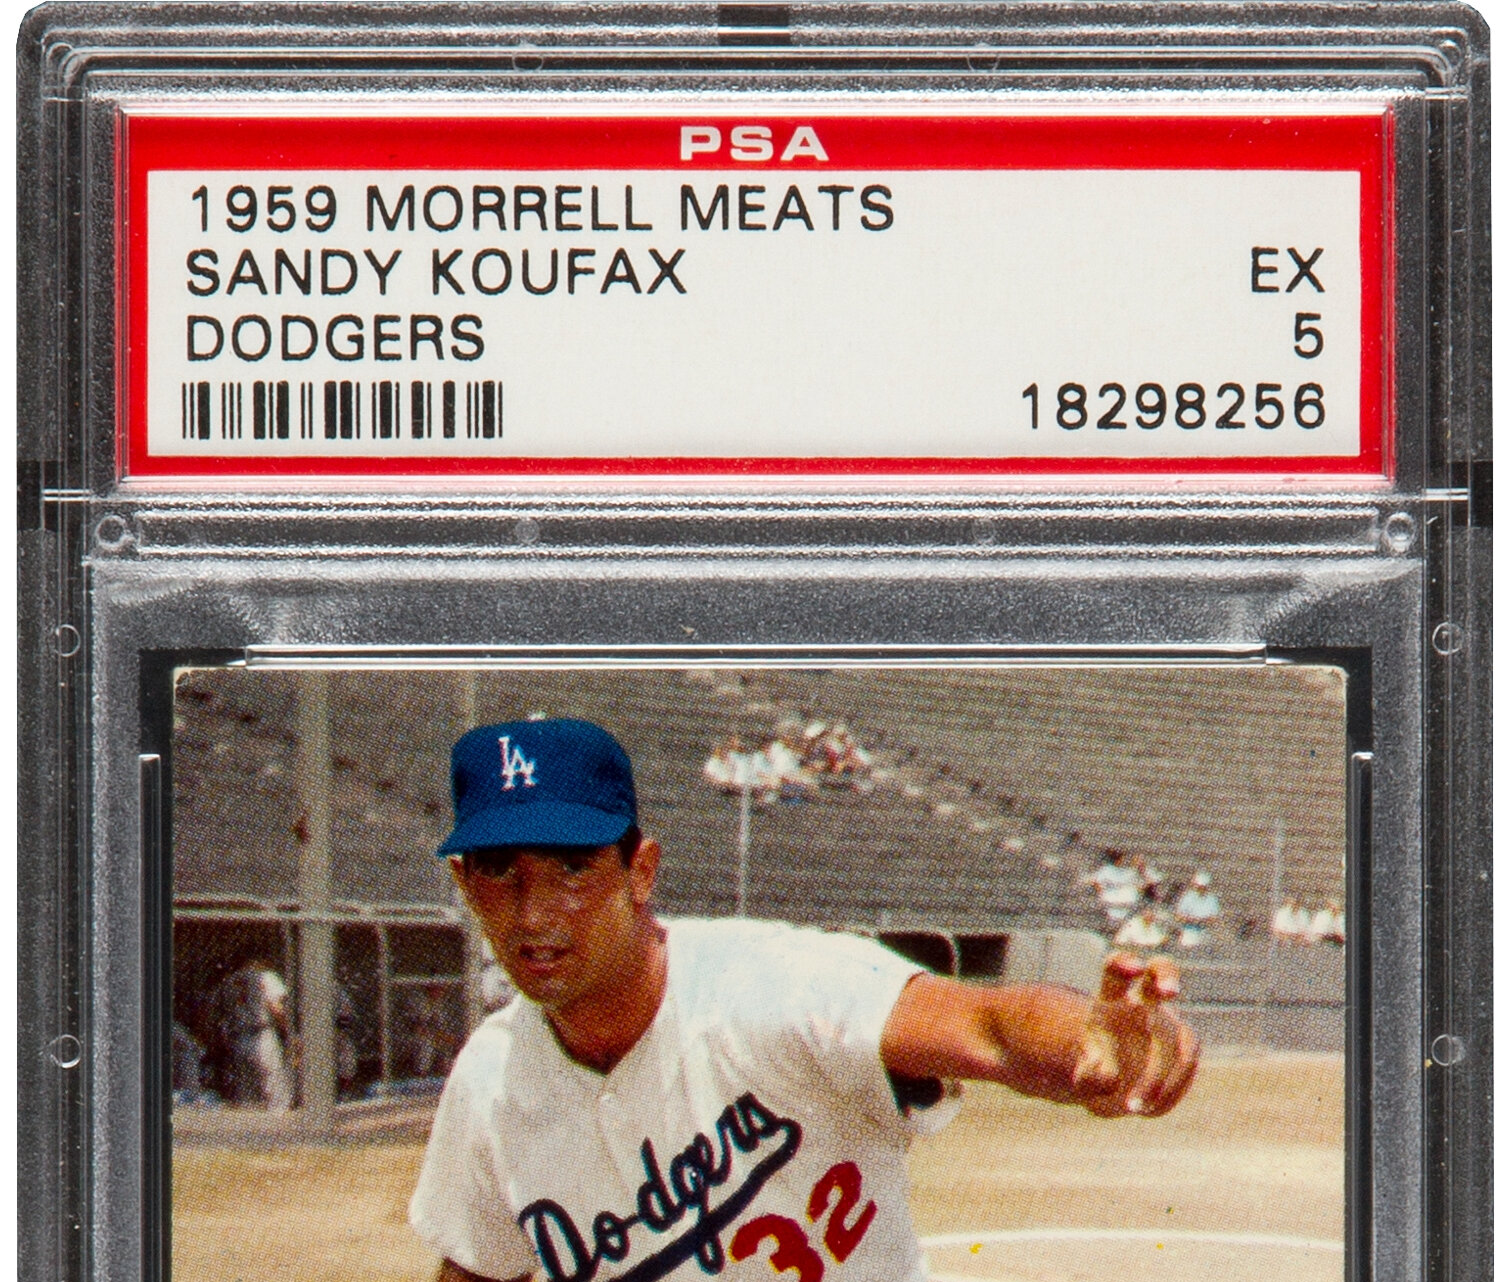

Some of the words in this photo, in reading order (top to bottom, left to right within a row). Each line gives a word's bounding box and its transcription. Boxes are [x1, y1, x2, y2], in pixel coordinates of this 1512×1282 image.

[680, 125, 829, 162] PSA
[192, 184, 337, 233] 1959
[366, 184, 653, 233] MORRELL
[680, 184, 894, 232] MEATS
[186, 248, 402, 297] SANDY
[432, 248, 687, 296] KOUFAX
[1251, 246, 1325, 293] EX
[187, 313, 485, 362] DODGERS
[1294, 312, 1324, 359] 5
[1022, 382, 1325, 431] 18298256
[498, 735, 537, 791] LA
